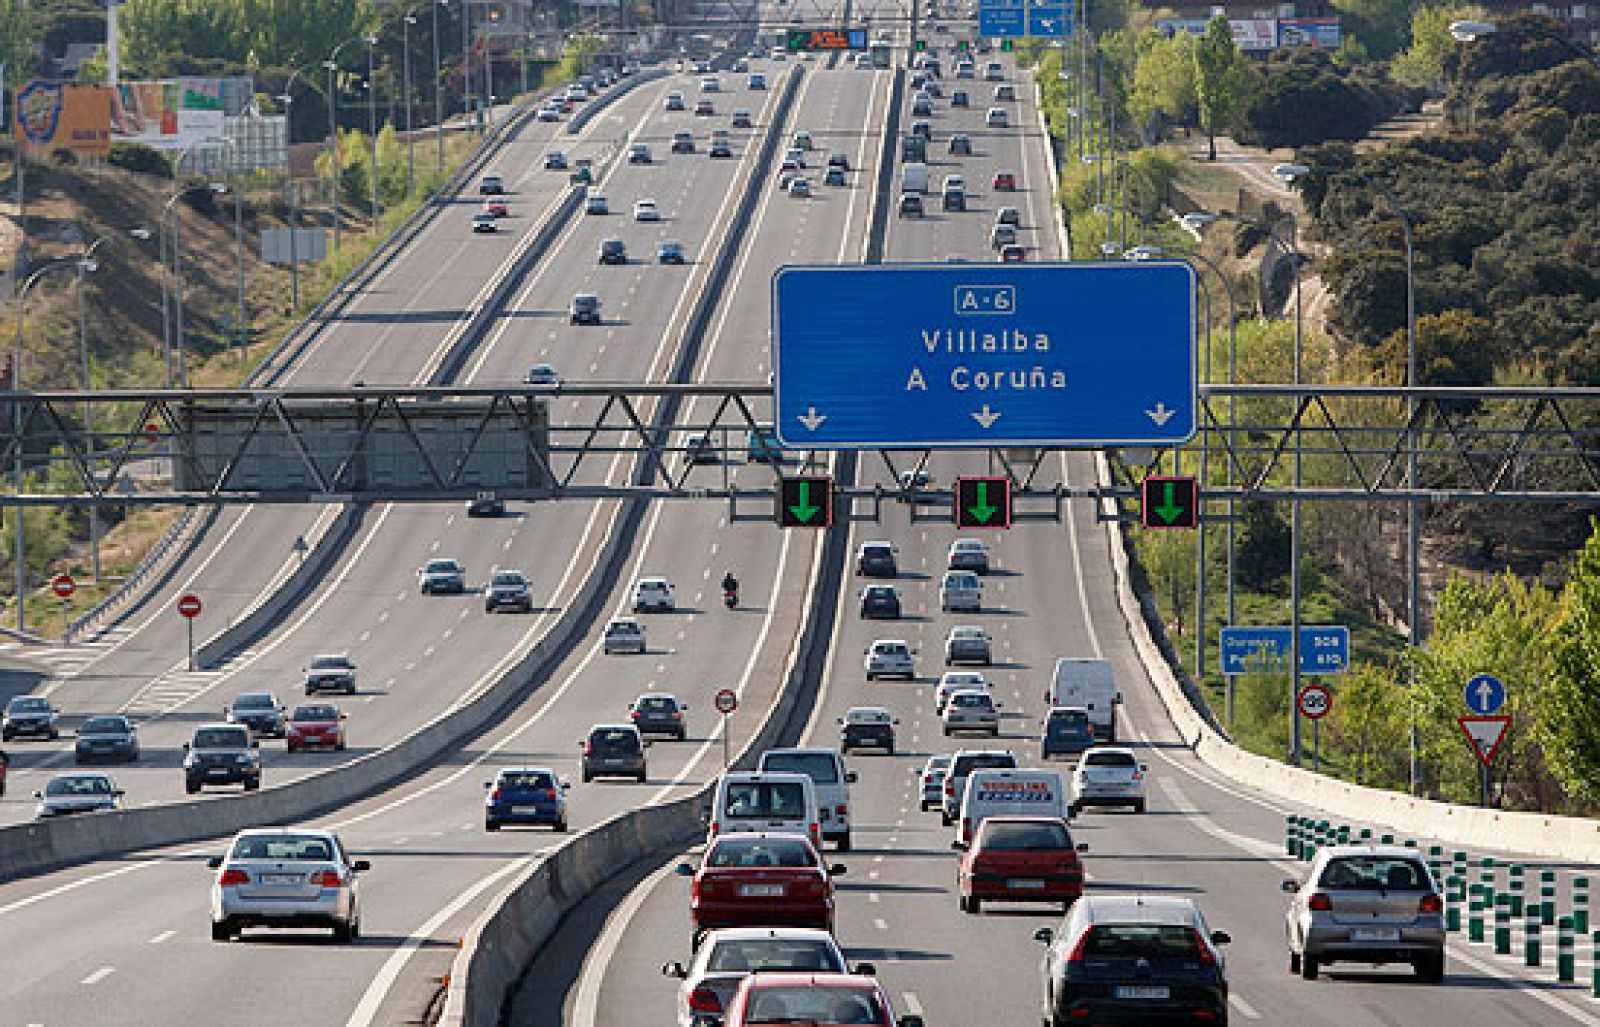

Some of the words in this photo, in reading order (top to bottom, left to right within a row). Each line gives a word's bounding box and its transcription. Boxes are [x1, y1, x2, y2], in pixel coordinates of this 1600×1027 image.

[921, 328, 1050, 353] Villalba
[906, 367, 928, 391] A
[950, 365, 1067, 391] Coruña
